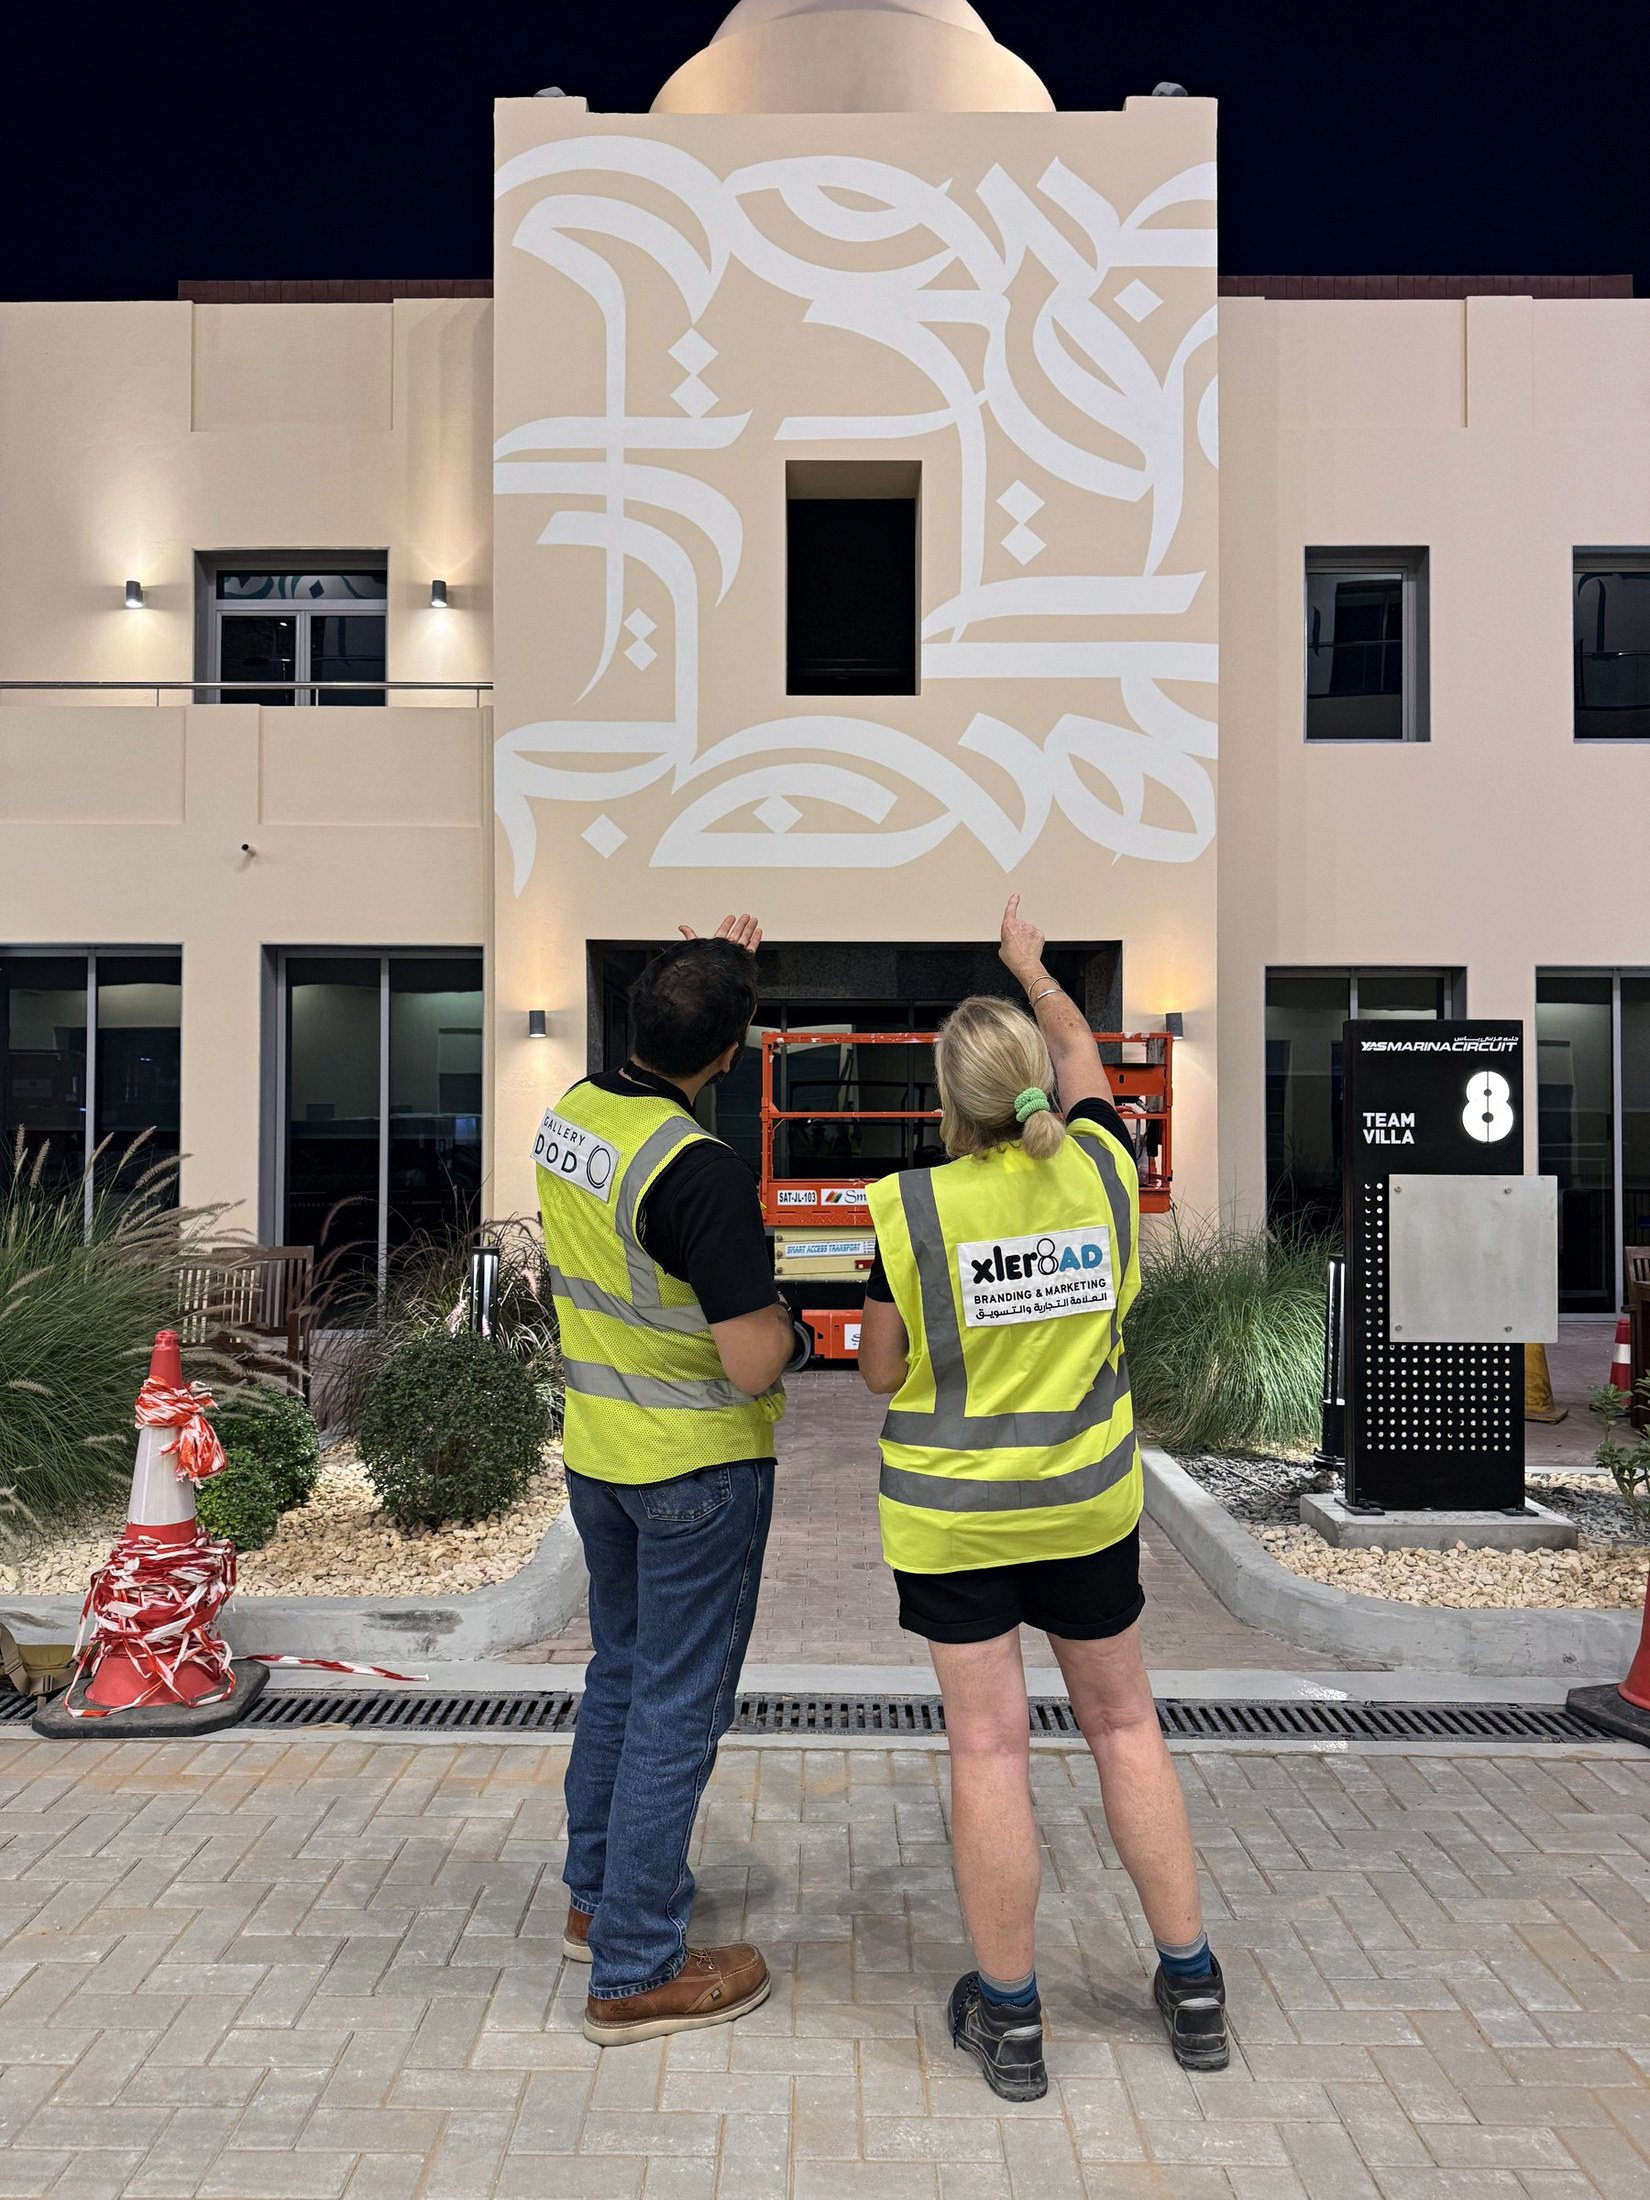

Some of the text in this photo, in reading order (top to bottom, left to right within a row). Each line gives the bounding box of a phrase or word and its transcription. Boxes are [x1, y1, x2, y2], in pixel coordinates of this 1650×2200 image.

[1461, 1070, 1514, 1143] 8
[1363, 1112, 1415, 1127] TEAM
[543, 1116, 586, 1146] GALLERY
[1363, 1129, 1415, 1144] VILLA
[779, 1191, 816, 1203] SAT-JL-103
[806, 1244, 828, 1254] ACCESS
[828, 1243, 861, 1253] TRANSPORT
[974, 1278, 1107, 1305] BRANDING & MARKETING
[975, 1293, 1108, 1320] العلامة التجارية والتسويق
